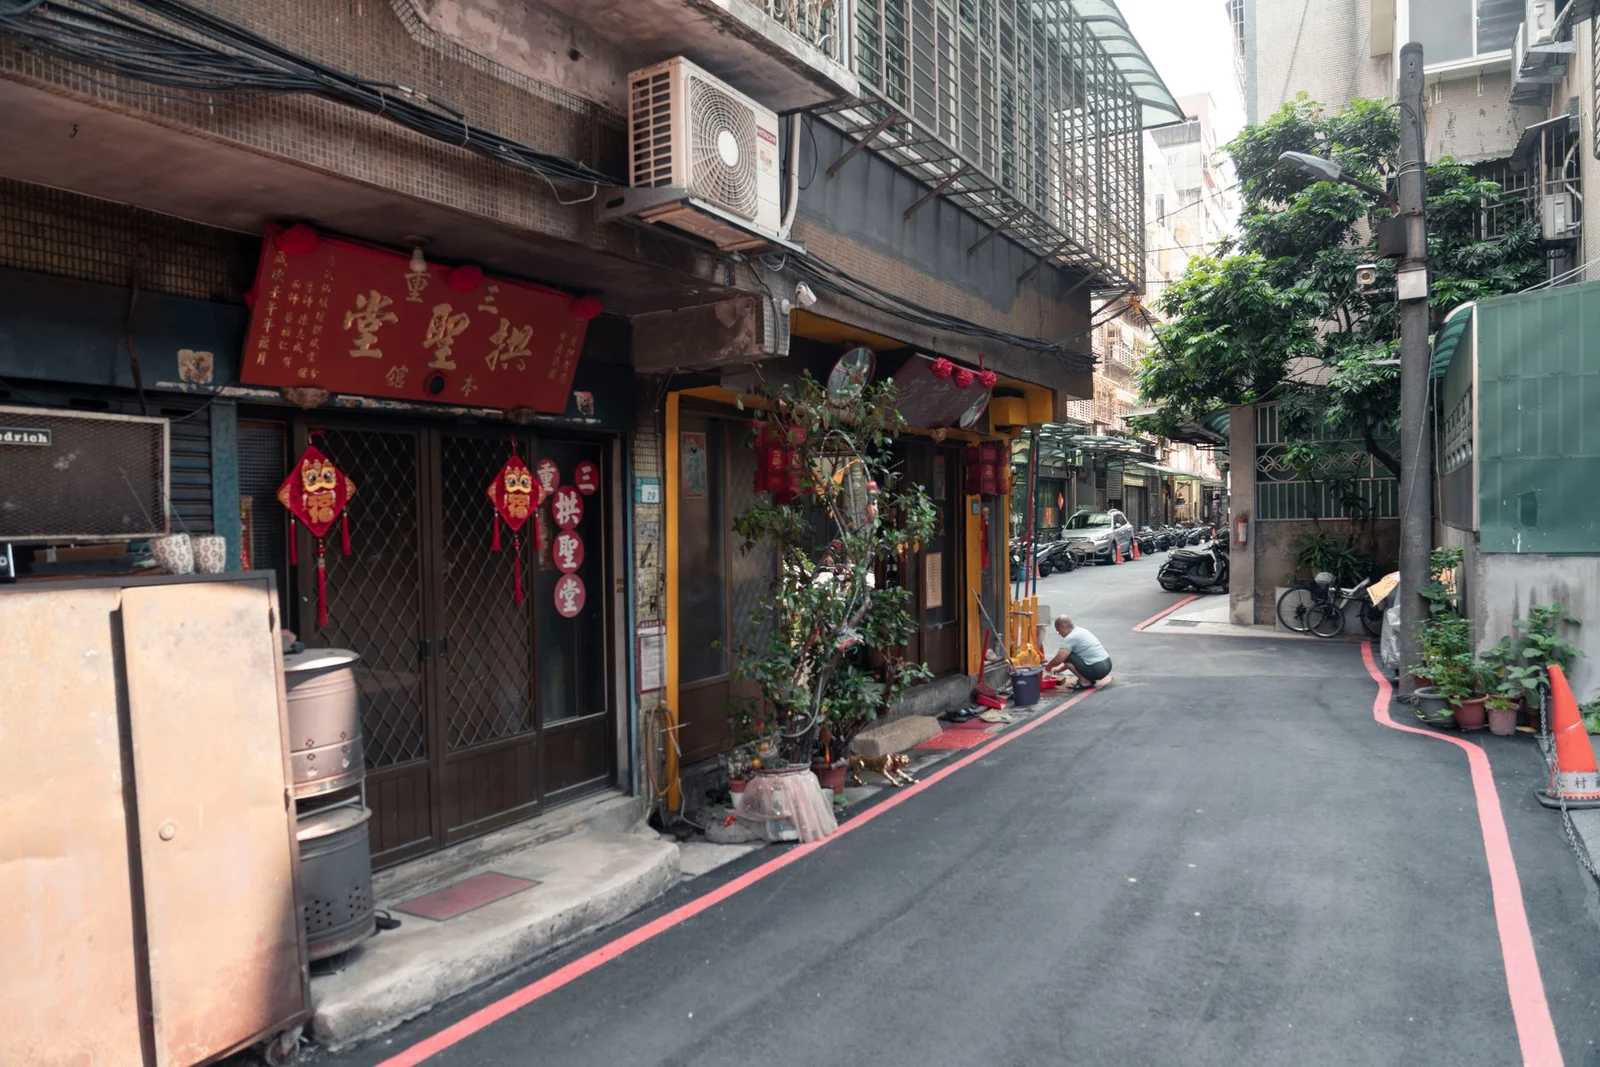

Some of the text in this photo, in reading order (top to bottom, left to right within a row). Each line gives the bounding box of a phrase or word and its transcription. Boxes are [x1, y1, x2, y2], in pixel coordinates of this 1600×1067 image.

[306, 494, 337, 524] 福
[507, 493, 529, 520] 福
[555, 490, 581, 612] 拱聖堂
